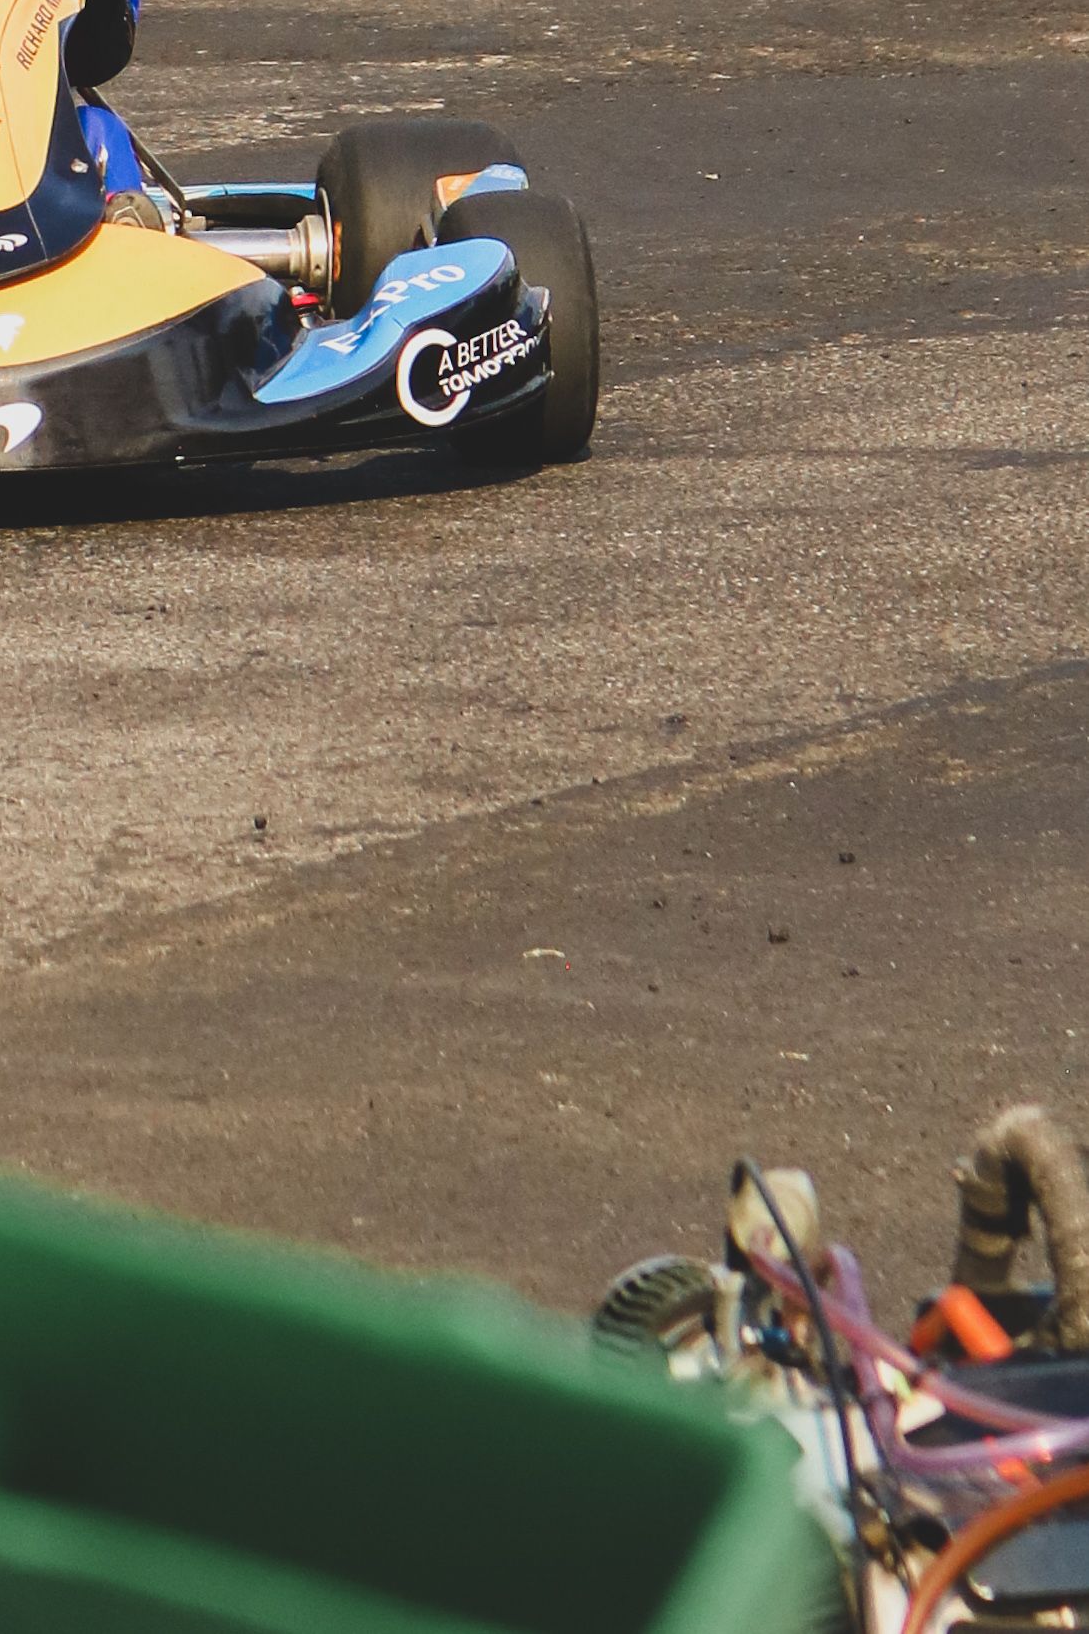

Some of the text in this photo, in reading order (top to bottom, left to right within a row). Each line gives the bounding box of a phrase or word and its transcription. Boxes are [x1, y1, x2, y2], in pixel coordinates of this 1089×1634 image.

[16, 5, 55, 71] RICHARD
[438, 319, 528, 376] A BETTER
